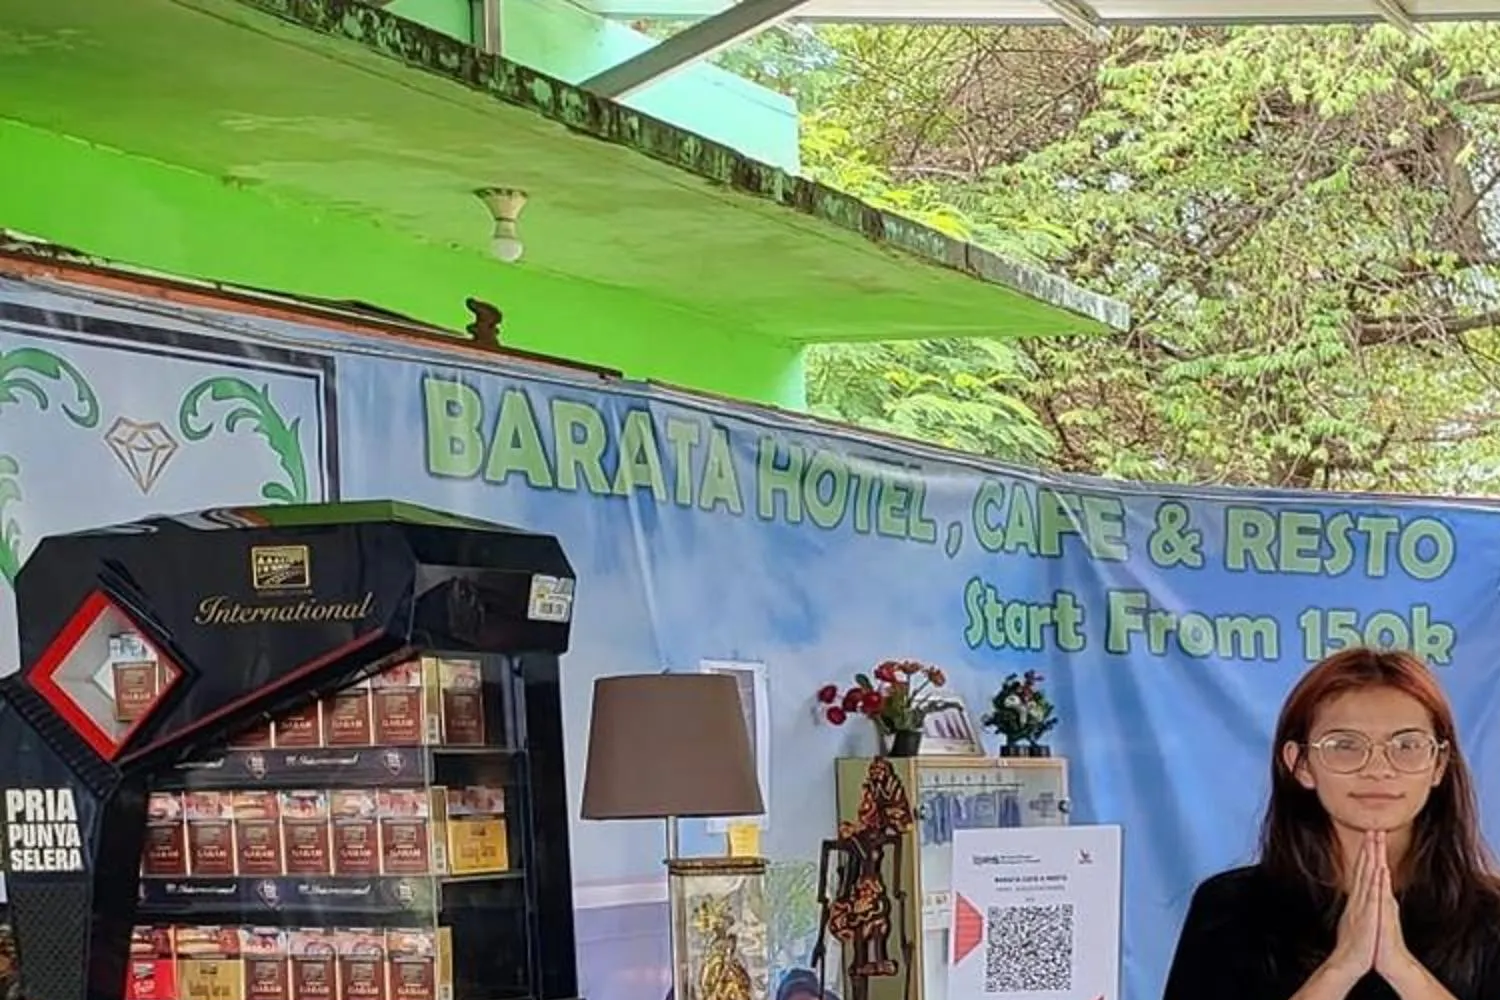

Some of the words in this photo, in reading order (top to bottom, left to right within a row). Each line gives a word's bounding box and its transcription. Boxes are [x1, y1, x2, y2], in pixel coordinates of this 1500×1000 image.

[421, 375, 744, 515] BARATA
[973, 477, 1129, 561] CAFE
[1148, 498, 1204, 570] &
[1224, 506, 1457, 582] RESTO
[194, 591, 374, 626] International
[963, 576, 1086, 653] Start
[1106, 588, 1280, 661] From
[1300, 603, 1457, 665] 150k
[5, 788, 78, 822] PRIA
[8, 823, 81, 848] PUNYA
[10, 848, 85, 872] SELERA
